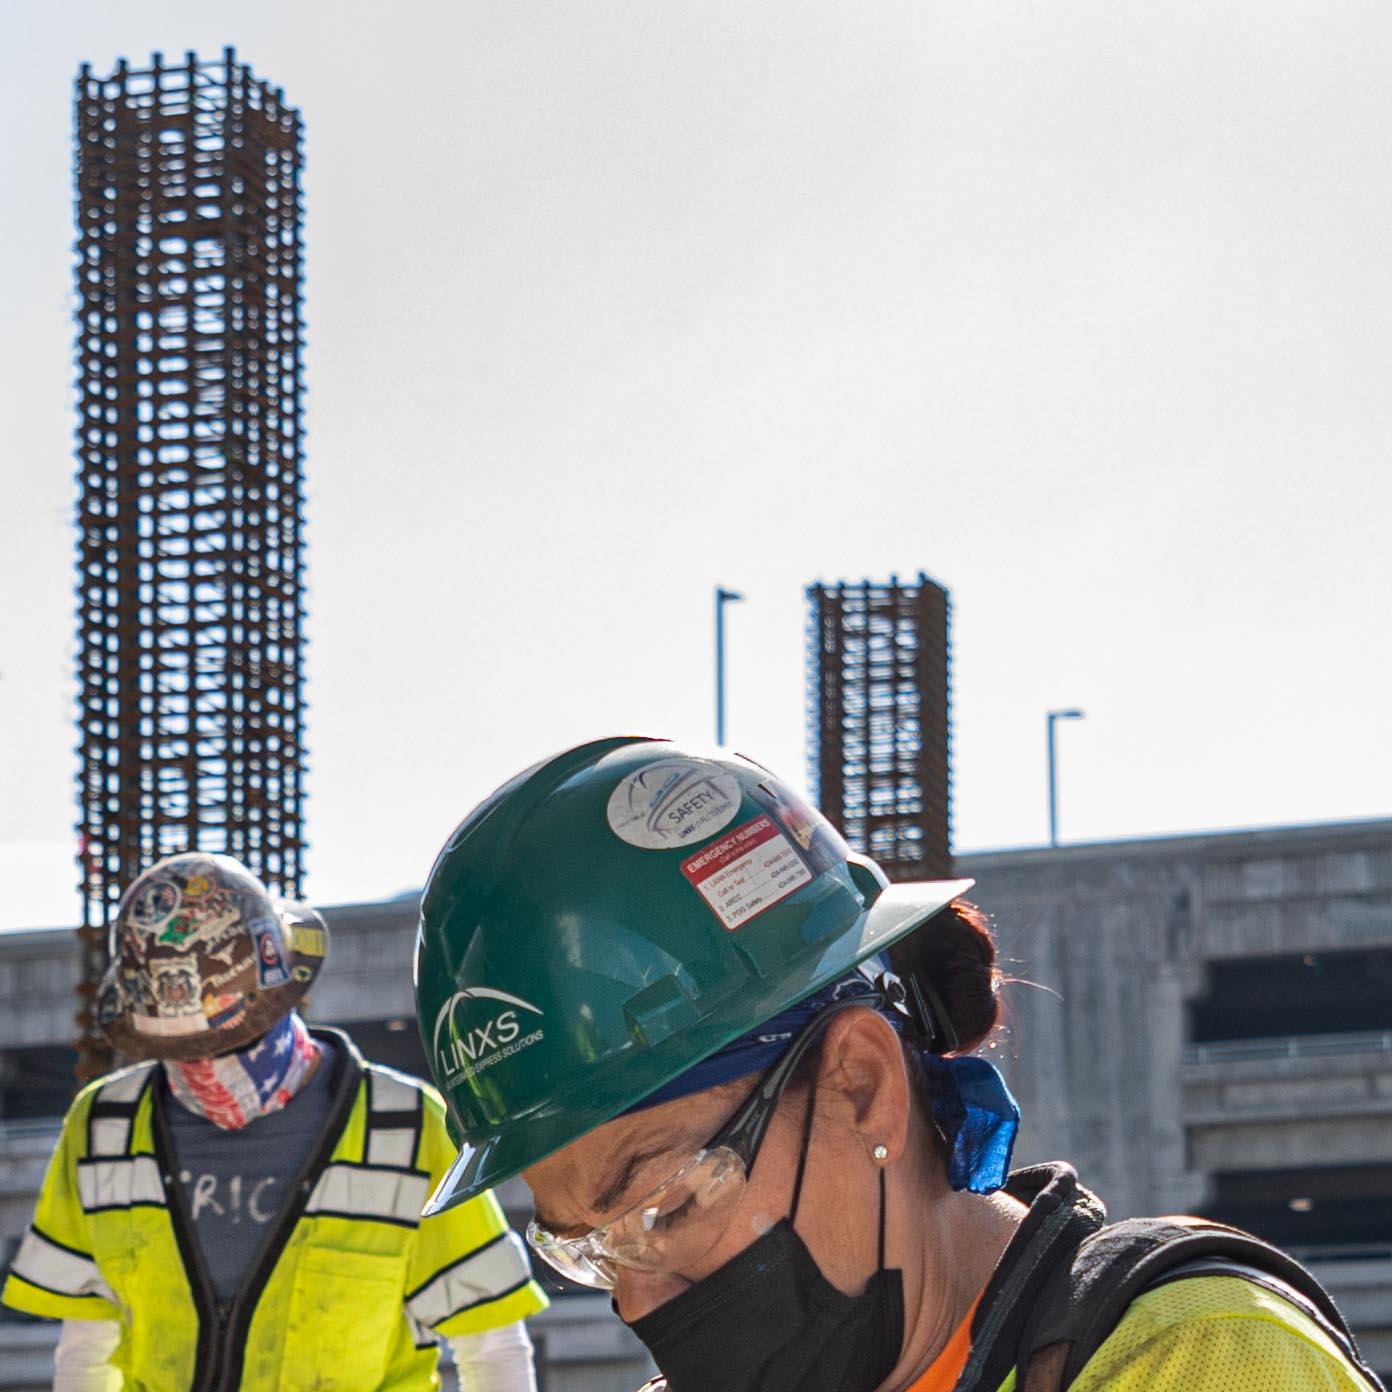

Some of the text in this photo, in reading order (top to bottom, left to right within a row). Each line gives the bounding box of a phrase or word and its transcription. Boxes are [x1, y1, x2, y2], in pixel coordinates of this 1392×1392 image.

[668, 791, 714, 825] SAFETY
[687, 836, 738, 874] EMERGENCY
[735, 818, 771, 842] NUMBERS
[440, 1010, 519, 1076] LINXS
[502, 1029, 544, 1060] SOLUTIONS
